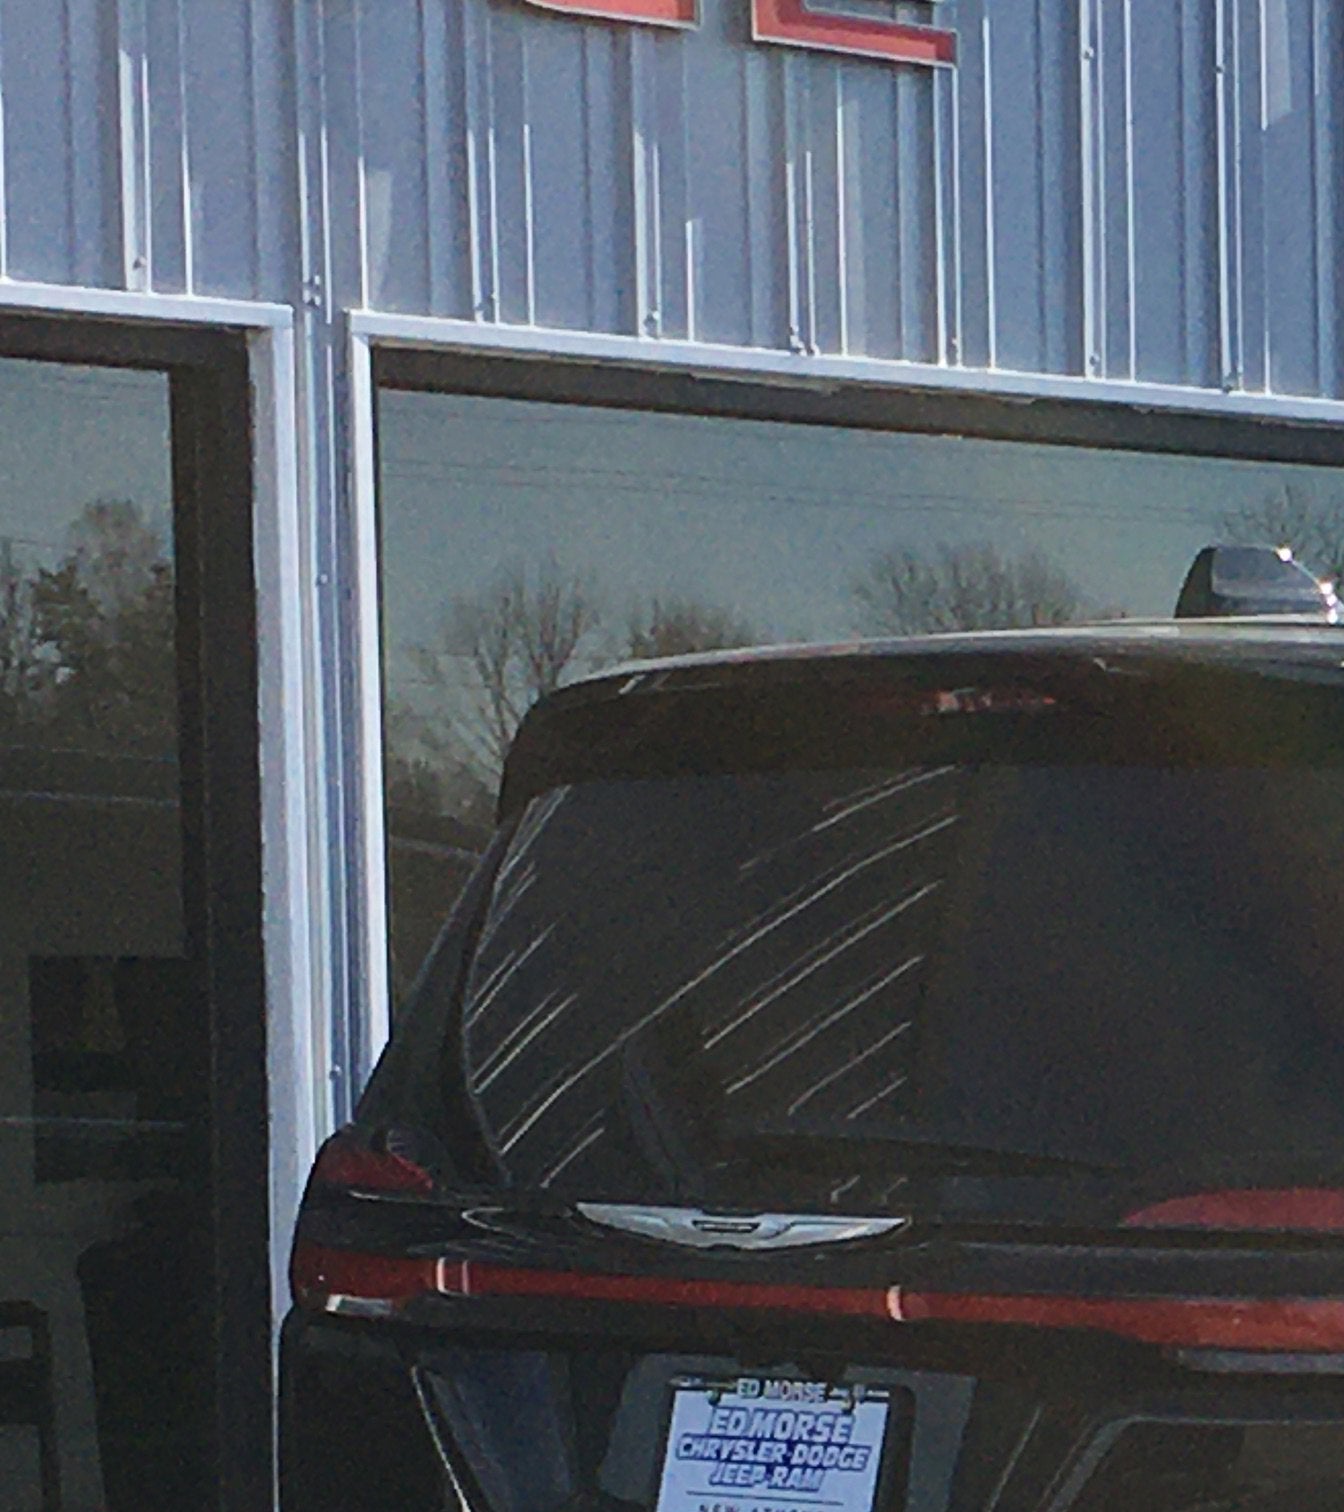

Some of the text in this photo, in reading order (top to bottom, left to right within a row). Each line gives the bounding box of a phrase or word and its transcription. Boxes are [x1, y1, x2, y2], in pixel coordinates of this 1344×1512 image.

[737, 1378, 759, 1399] ED
[764, 1380, 827, 1403] MORSE
[708, 1407, 854, 1444] ED MORSE
